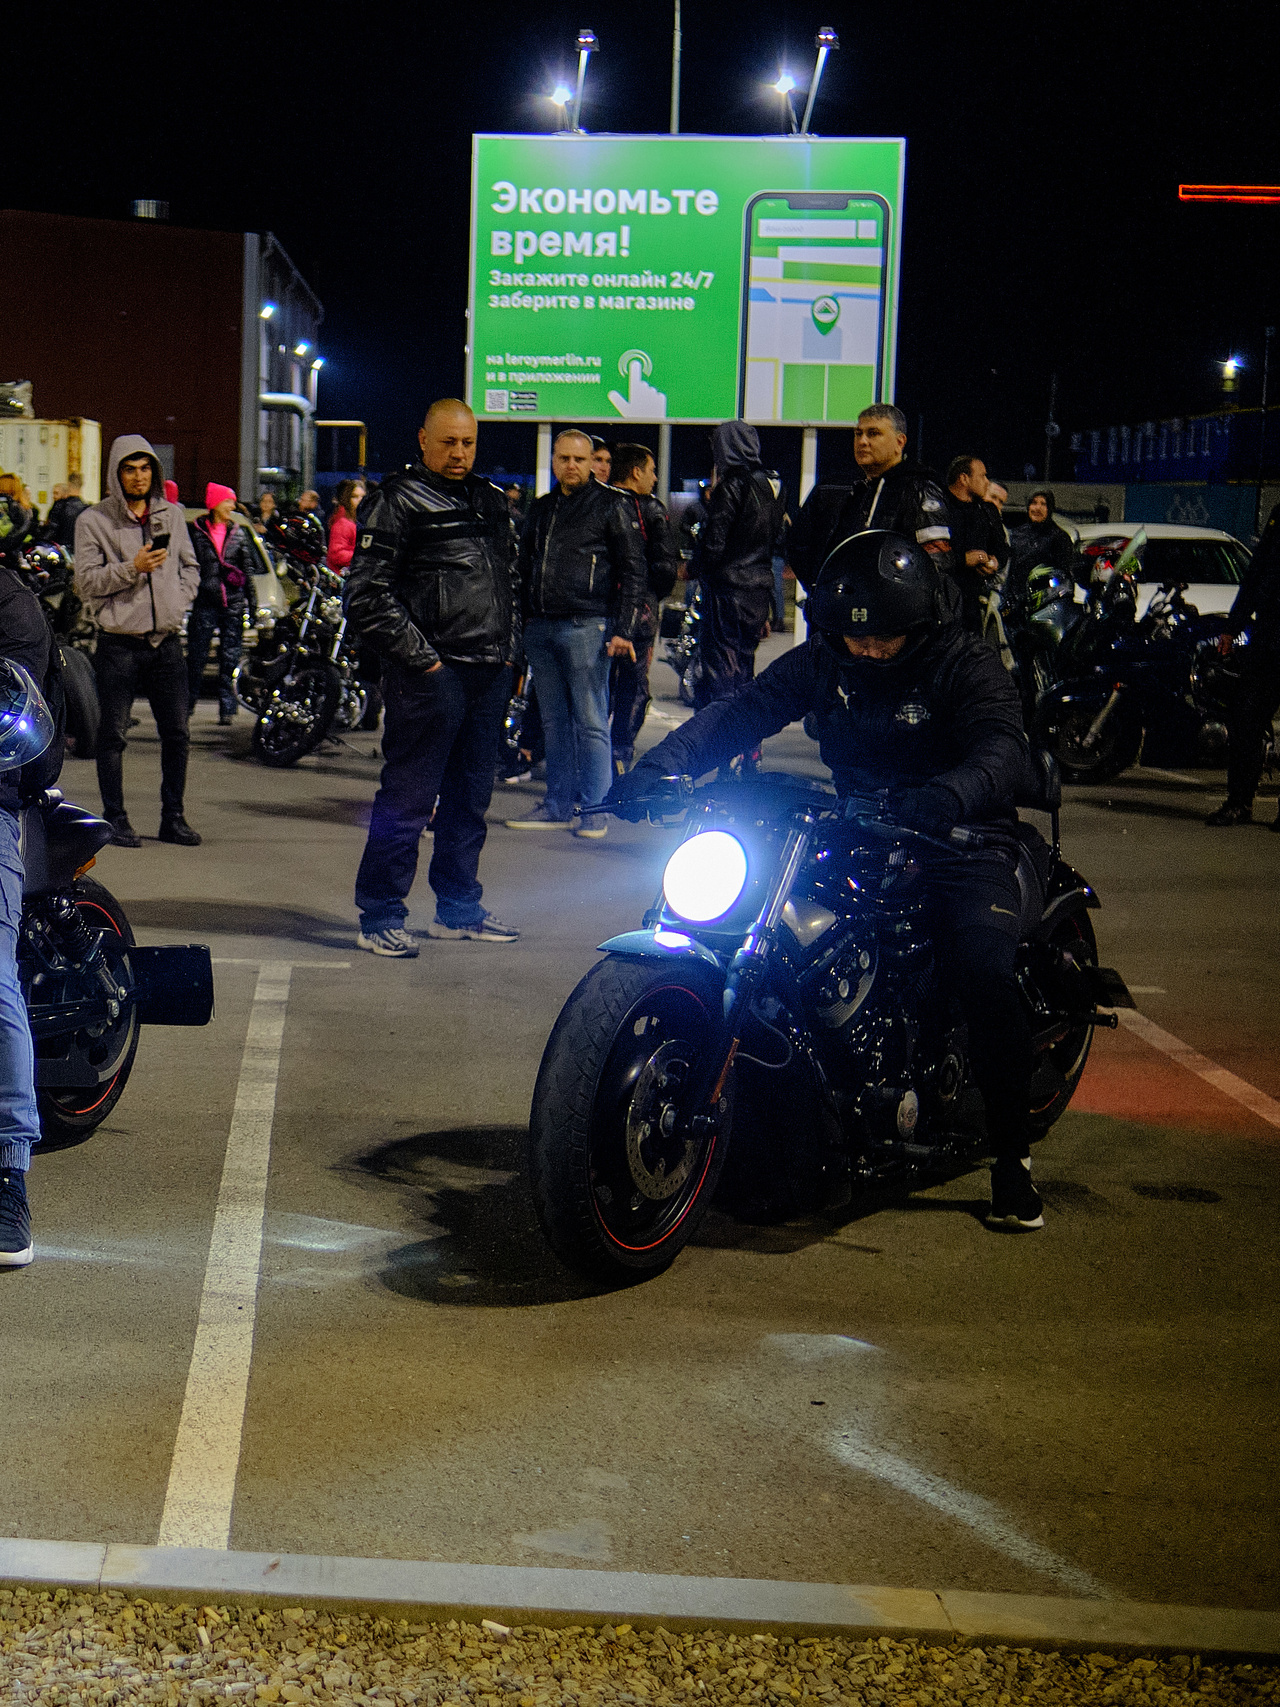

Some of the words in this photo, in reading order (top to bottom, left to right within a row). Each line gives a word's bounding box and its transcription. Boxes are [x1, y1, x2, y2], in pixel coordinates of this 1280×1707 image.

[491, 181, 719, 215] Экономьте
[490, 226, 630, 263] время!
[488, 270, 588, 288] Закажите
[592, 270, 667, 289] онлайн
[670, 271, 715, 290] 24/7
[488, 292, 581, 312] заберите
[586, 296, 596, 309] в
[599, 296, 695, 311] магазине
[486, 355, 504, 366] на
[505, 353, 602, 368] leroymerlin.ru
[486, 372, 496, 382] и
[497, 372, 506, 382] в
[508, 372, 601, 385] приложении
